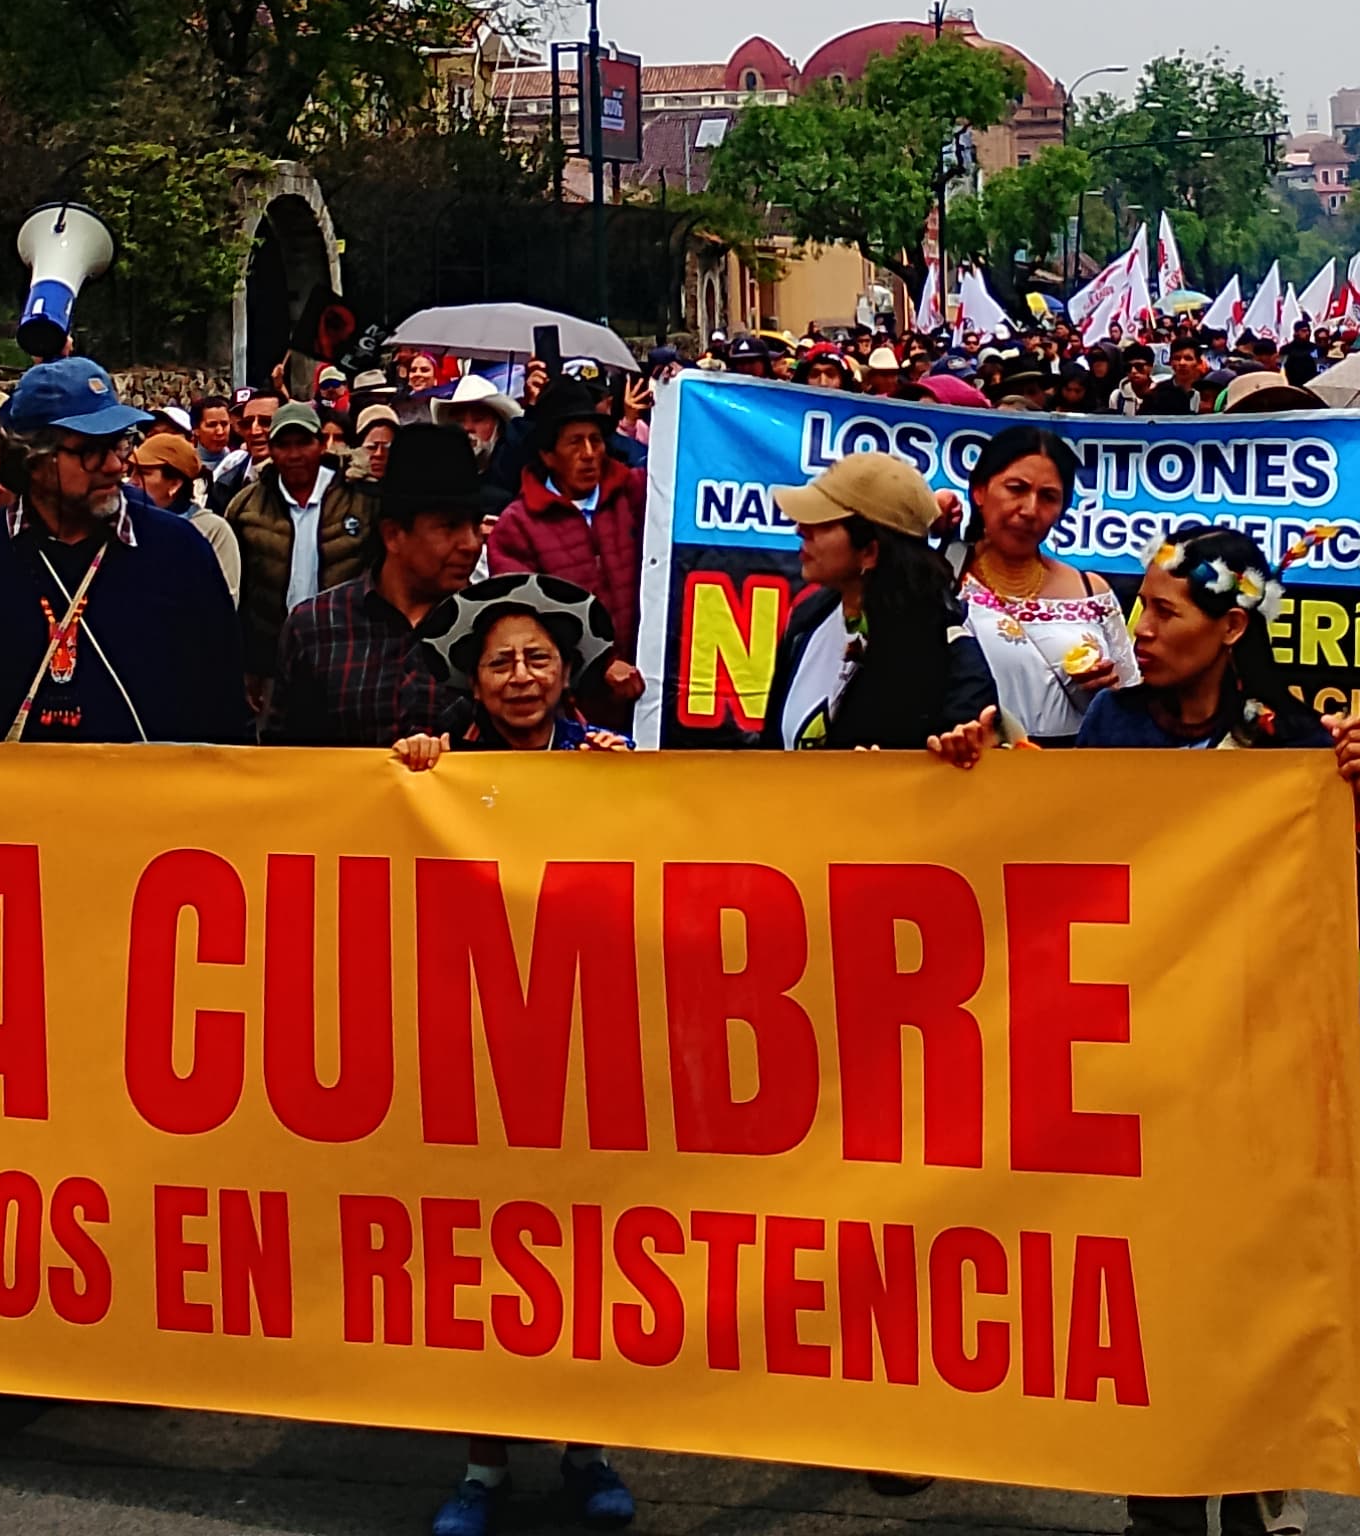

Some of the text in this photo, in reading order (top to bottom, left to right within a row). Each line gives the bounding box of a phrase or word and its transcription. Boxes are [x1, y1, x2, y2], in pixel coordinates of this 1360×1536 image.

[806, 417, 934, 473] LOS
[124, 847, 1142, 1177] CUMBRE
[154, 1182, 293, 1339] EN
[339, 1192, 1150, 1407] RESISTENCIA
